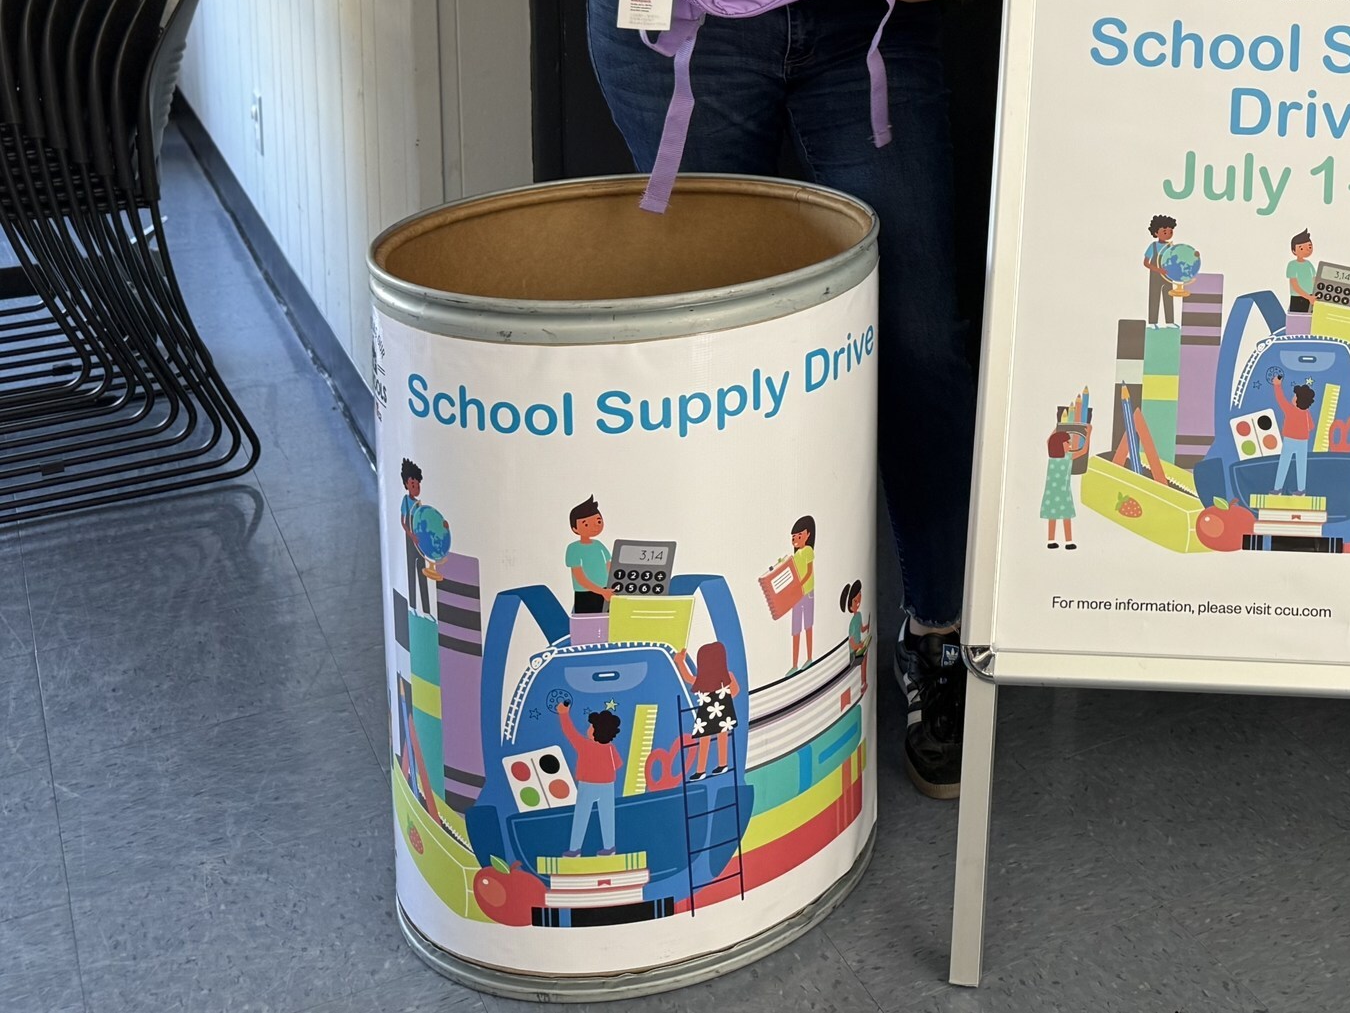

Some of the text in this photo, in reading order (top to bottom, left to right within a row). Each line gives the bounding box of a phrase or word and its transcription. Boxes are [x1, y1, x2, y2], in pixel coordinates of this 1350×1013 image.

[1090, 17, 1300, 72] School
[1163, 151, 1291, 216] July
[408, 374, 572, 436] School
[596, 369, 790, 438] Supply
[806, 325, 873, 392] Drive
[1052, 596, 1331, 618] For more information, please visit ccu.com
